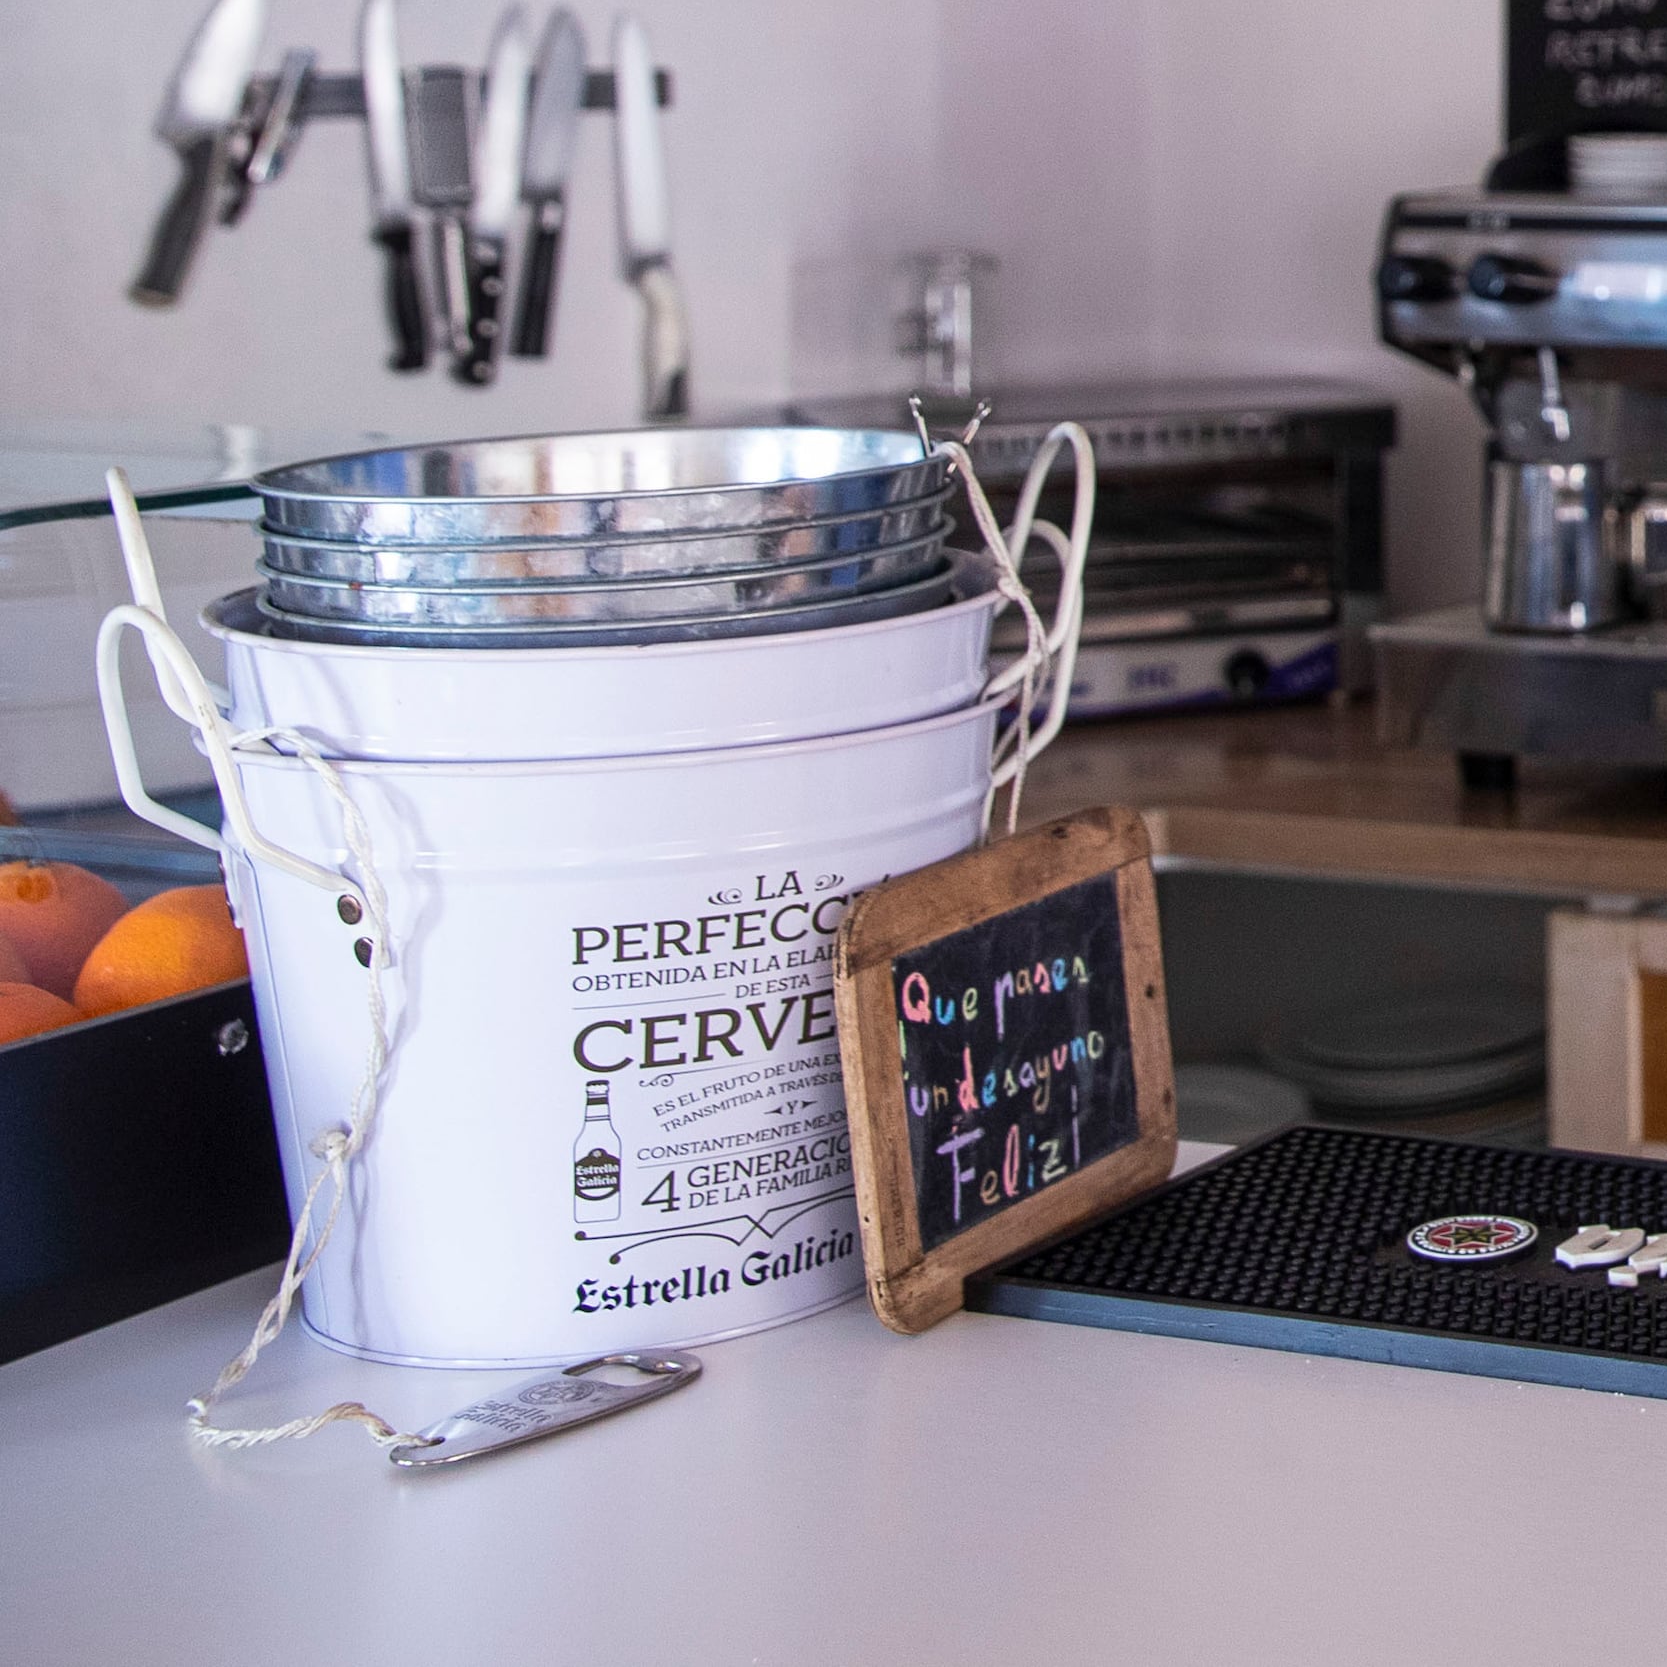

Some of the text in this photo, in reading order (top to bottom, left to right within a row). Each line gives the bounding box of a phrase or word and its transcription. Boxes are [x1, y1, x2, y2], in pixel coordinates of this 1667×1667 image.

[755, 870, 804, 902] LA
[572, 890, 862, 966] PERFECC
[572, 965, 707, 993] OBTENIDA
[711, 958, 747, 980] EN
[752, 954, 782, 975] LA
[735, 973, 811, 999] DE ESTA
[902, 956, 1090, 1042] Que pases
[652, 1101, 677, 1117] ES
[678, 1092, 701, 1111] EL
[702, 1071, 761, 1099] FRUTO
[763, 1064, 787, 1080] DE
[788, 1055, 821, 1073] UNA
[660, 1089, 763, 1134] TRANSMITIDA
[766, 1086, 776, 1098] A
[786, 1099, 798, 1115] Y
[636, 1121, 803, 1161] CONSTANTEMENTE
[575, 1162, 620, 1176] Estrella
[576, 1175, 618, 1187] Galicia
[688, 1191, 720, 1210] DE
[723, 1182, 752, 1204] LA
[756, 1161, 833, 1191] FAMILIA
[641, 1170, 681, 1213] 4
[572, 1228, 854, 1313] Estrella Galicia
